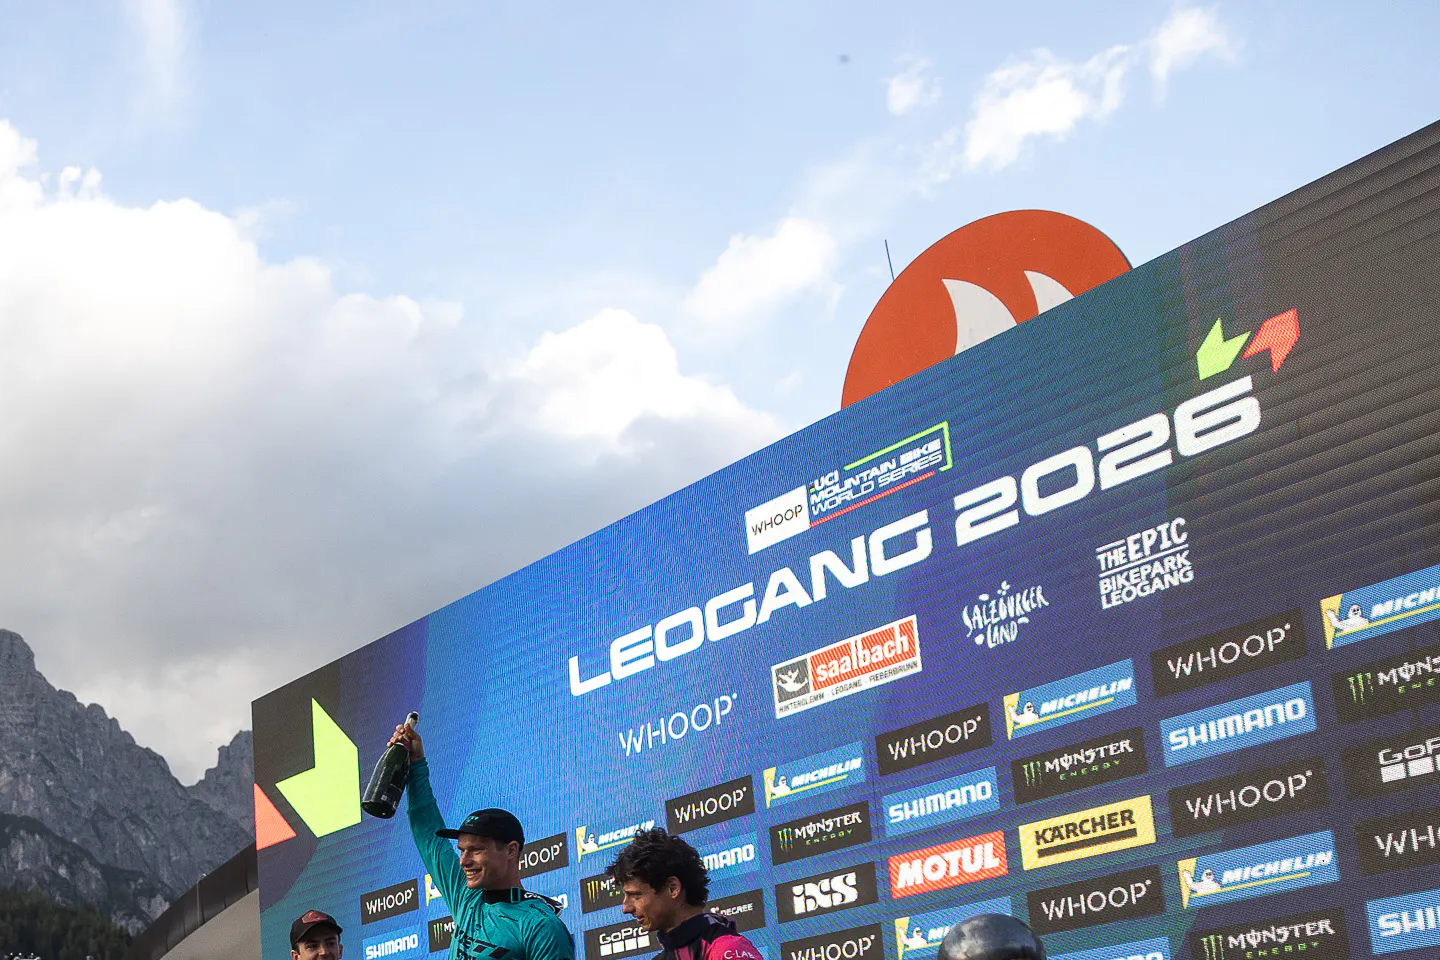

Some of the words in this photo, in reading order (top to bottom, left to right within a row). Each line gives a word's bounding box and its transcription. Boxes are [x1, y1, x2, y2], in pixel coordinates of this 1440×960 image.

[810, 458, 896, 504] MOUNTAIN
[900, 438, 941, 465] BIKE
[812, 483, 874, 516] WORLD
[877, 450, 943, 487] SERIES
[814, 470, 839, 491] UCI
[568, 508, 933, 697] LEOGANG
[954, 375, 1261, 546] 2026
[751, 504, 803, 536] WHOOP
[1096, 545, 1127, 571] THE
[1127, 517, 1189, 562] EPIC
[1099, 550, 1192, 594] BIKEPARK
[1101, 568, 1194, 609] LEOGANG
[962, 584, 1050, 637] SALZBURGER
[1371, 587, 1440, 618] MICH
[817, 625, 909, 682] saalbach
[987, 620, 1018, 649] LAND
[1167, 625, 1289, 679] WHOOP
[1377, 656, 1440, 685] MONS
[1040, 676, 1133, 715] MICHELIN
[619, 695, 734, 756] WHOOP
[887, 717, 979, 761] WHOOP
[1170, 697, 1306, 751] SHIMANO
[1044, 738, 1134, 774] MONSTER
[1378, 736, 1440, 766] GoP
[792, 757, 862, 787] MICHELIN
[675, 789, 746, 824] WHOOP
[889, 781, 992, 824] SHIMANO
[1186, 772, 1310, 819] WHOOP
[795, 811, 863, 839] MONSTER
[1034, 808, 1136, 846] KÄRCHER
[518, 845, 561, 871] HOOP
[702, 844, 755, 871] MANO
[896, 843, 1000, 890] MOTUL
[1222, 850, 1332, 885] MICHELIN
[366, 890, 413, 915] WHOOP
[1041, 881, 1149, 921] WHOOP
[365, 933, 419, 960] SHIMANO
[1228, 918, 1335, 952] MONSTER
